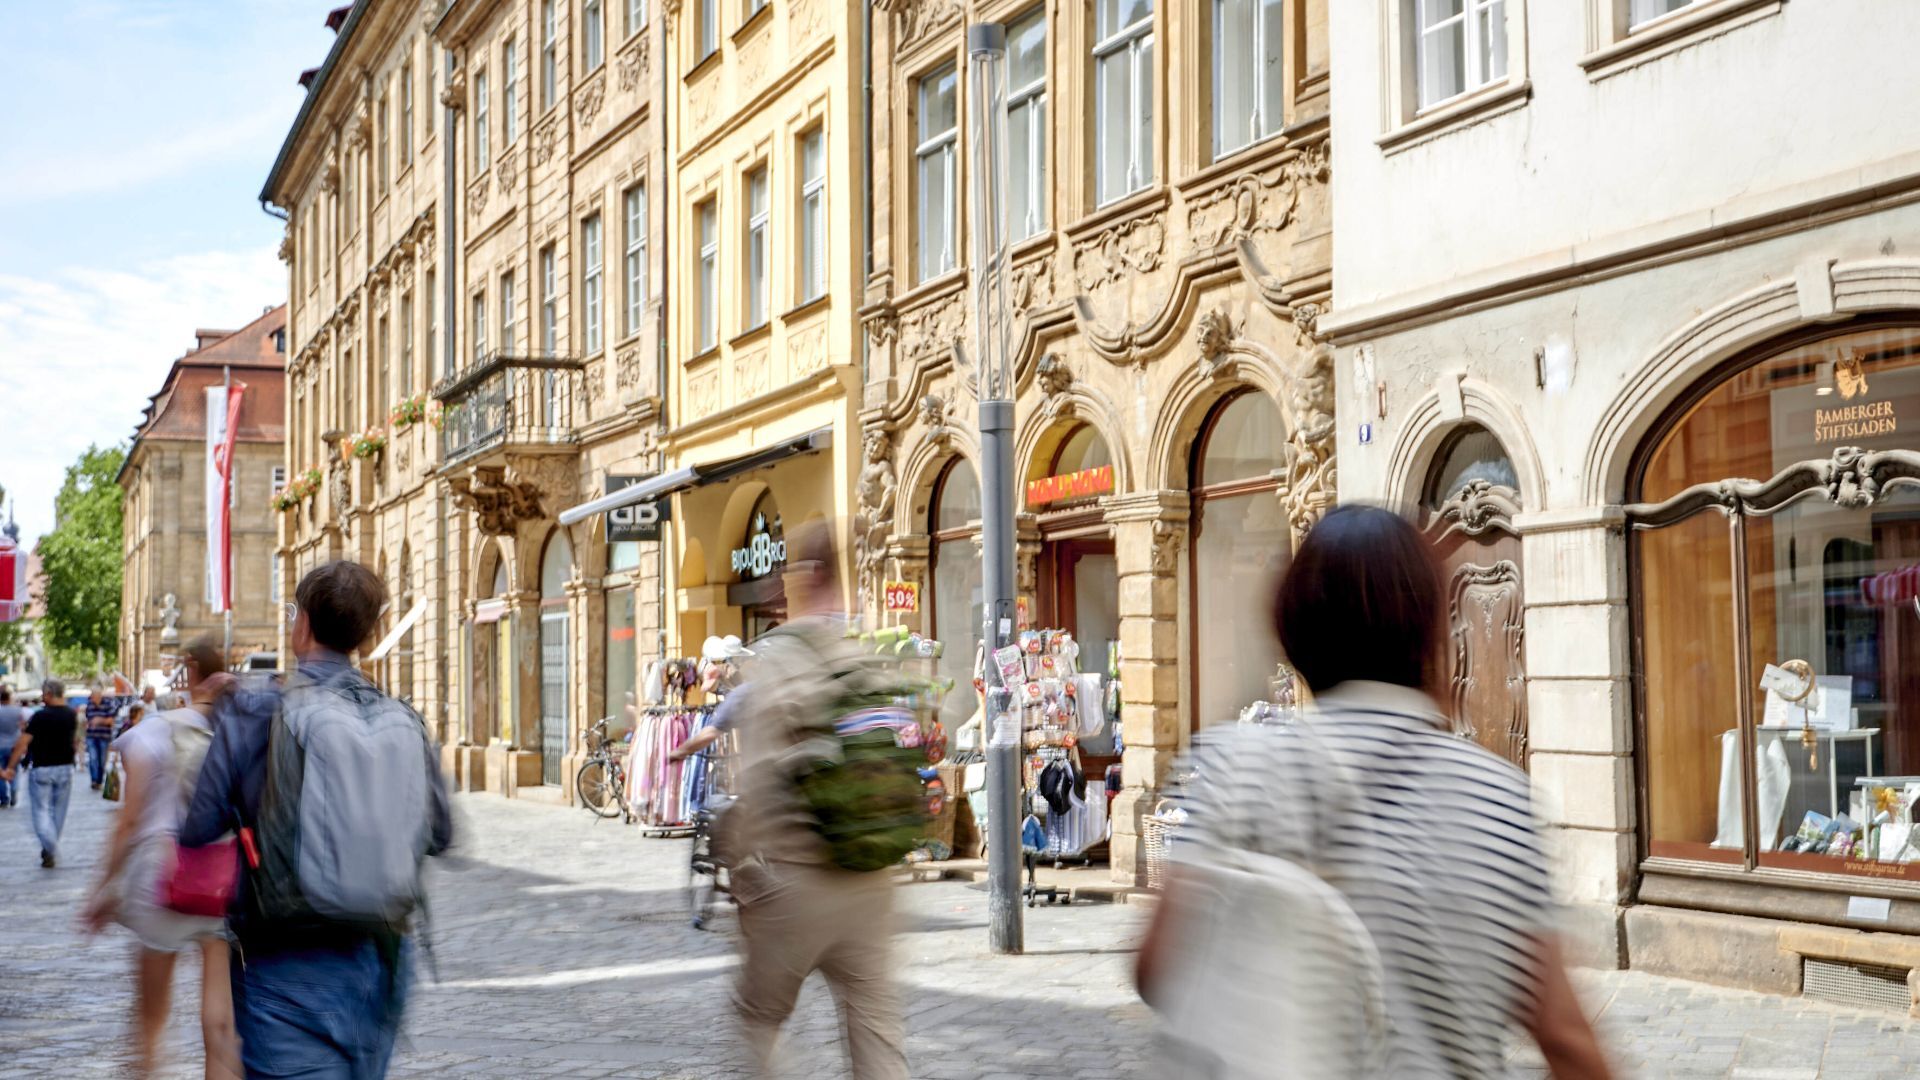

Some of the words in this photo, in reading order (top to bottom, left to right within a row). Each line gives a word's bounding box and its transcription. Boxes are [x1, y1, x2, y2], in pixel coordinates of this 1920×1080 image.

[1815, 401, 1894, 425] BAMBERGER
[1815, 417, 1896, 441] STIFTSLADEN
[887, 590, 915, 607] 50%
